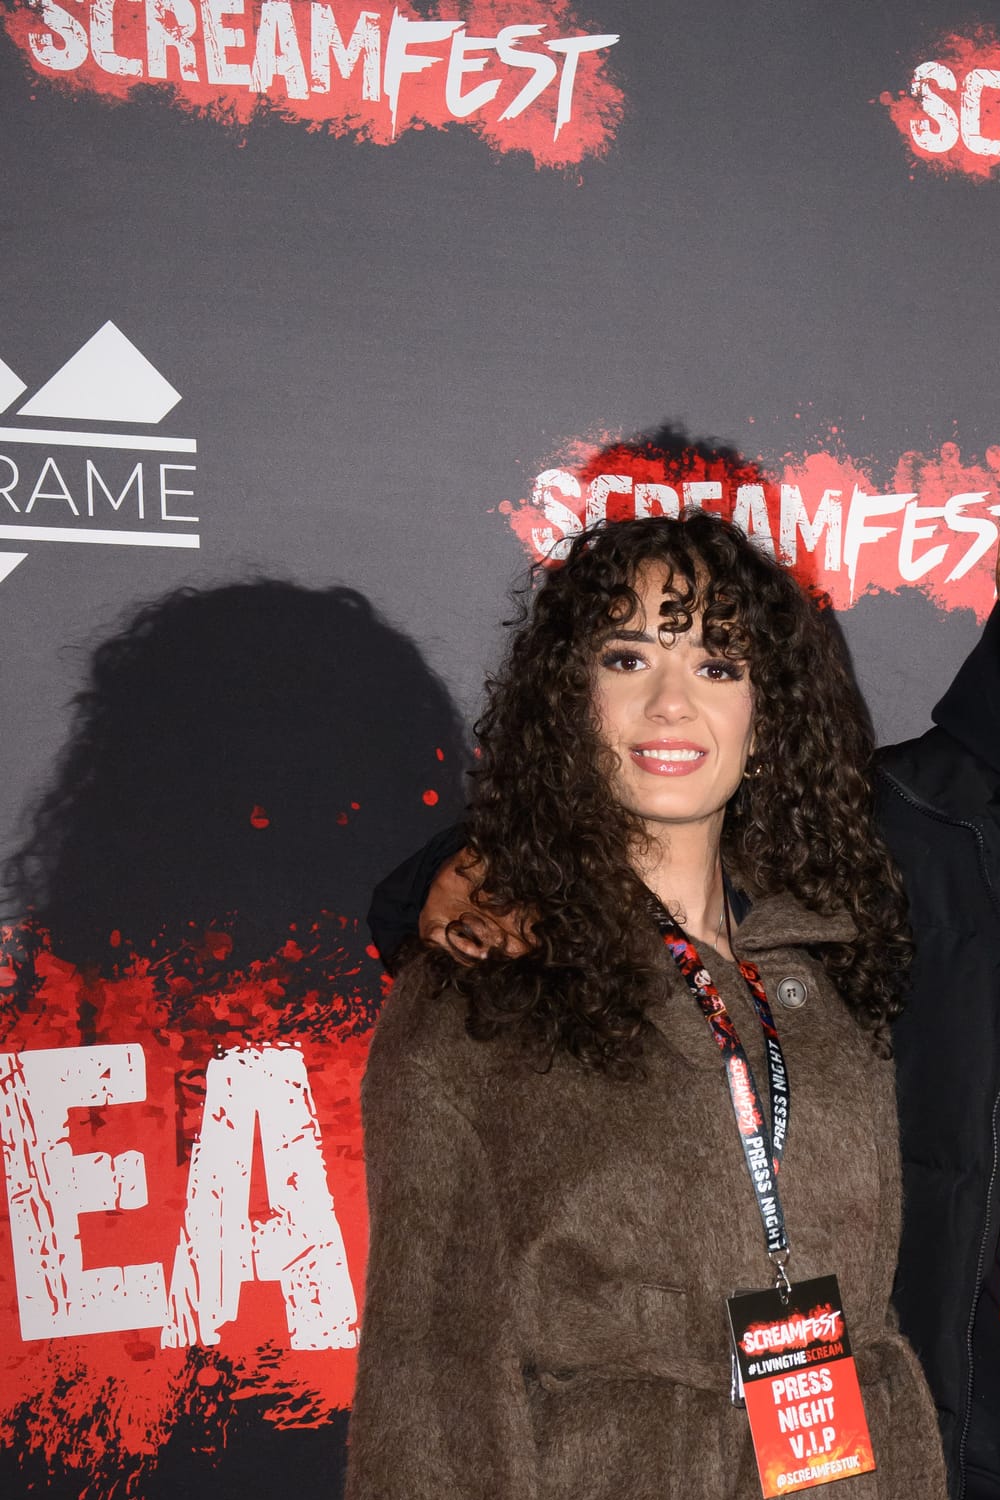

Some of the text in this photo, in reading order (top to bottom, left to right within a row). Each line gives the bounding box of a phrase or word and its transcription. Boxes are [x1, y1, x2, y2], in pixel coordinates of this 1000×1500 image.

[27, 0, 620, 142] SCREAMFEST
[768, 1039, 788, 1150] PRESS NIGHT
[0, 1042, 361, 1350] EA
[745, 1135, 772, 1198] PRESS
[760, 1199, 781, 1250] NIGHT
[742, 1310, 842, 1354] SCREAMFEST
[771, 1368, 834, 1405] PRESS
[777, 1397, 836, 1433] NIGHT
[789, 1426, 836, 1459] V.I.P
[776, 1455, 861, 1489] @SCREAMFESTUK
